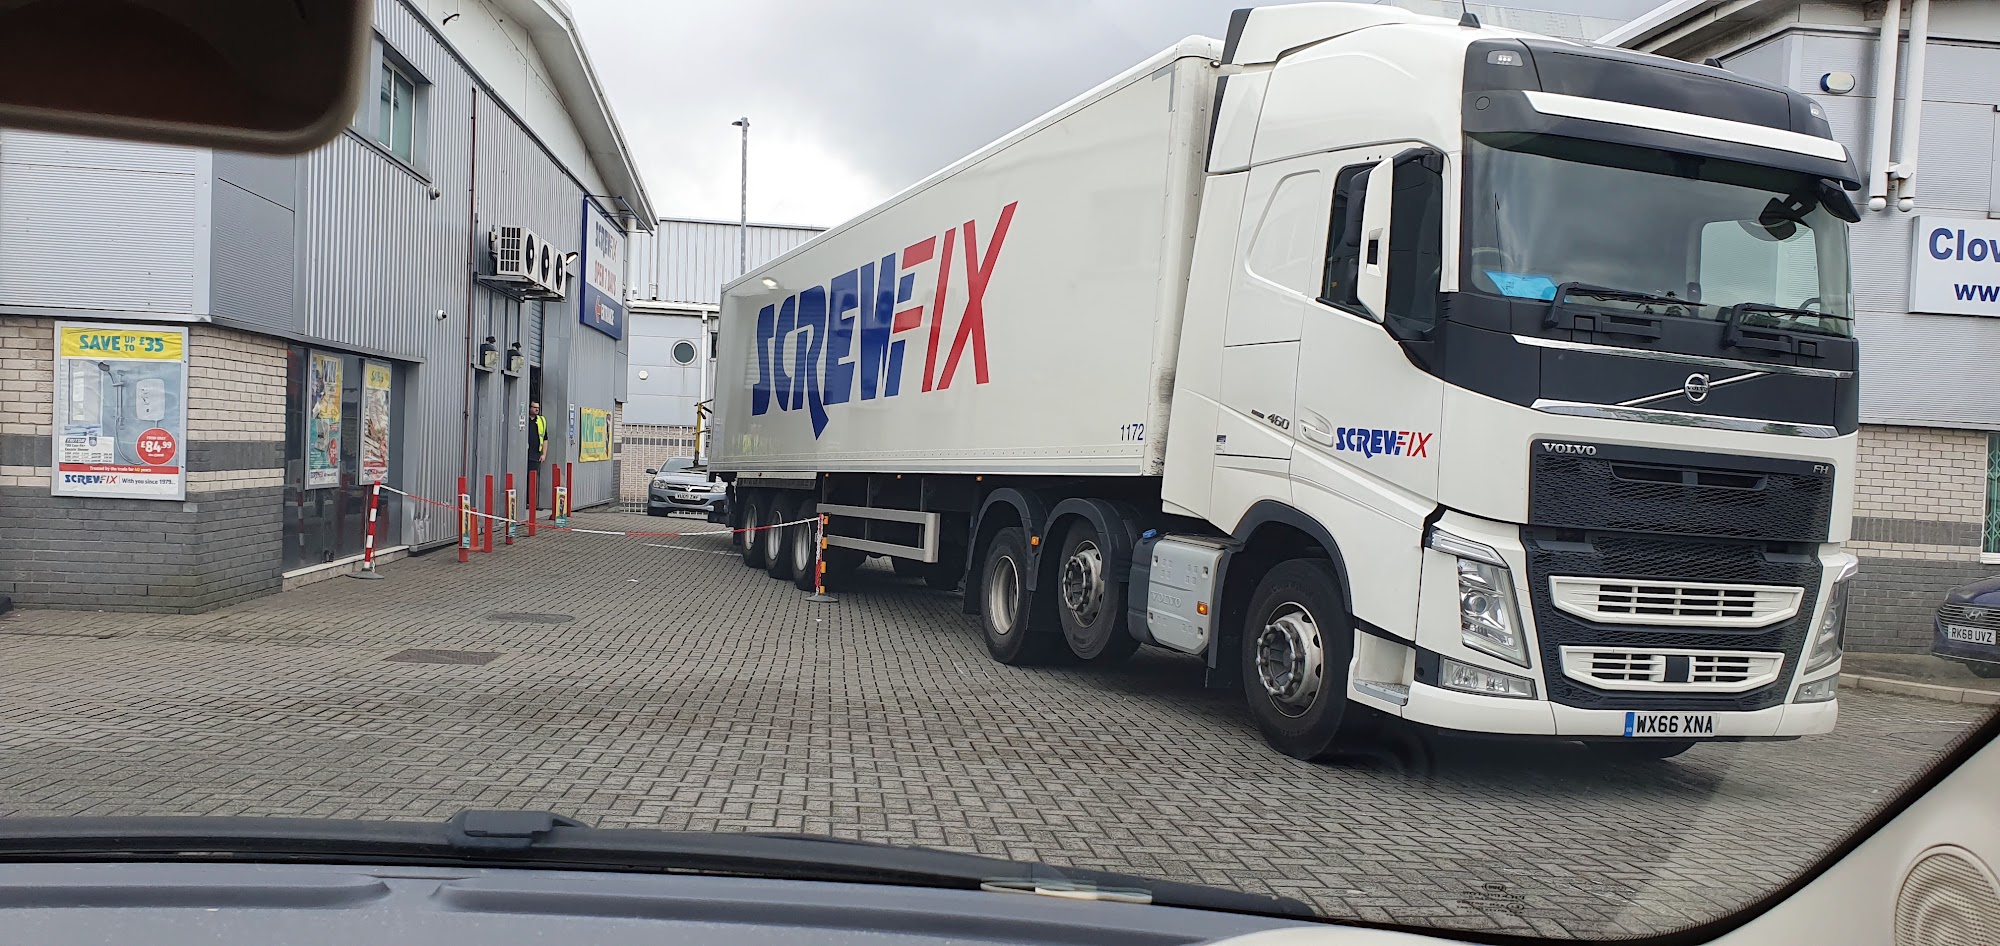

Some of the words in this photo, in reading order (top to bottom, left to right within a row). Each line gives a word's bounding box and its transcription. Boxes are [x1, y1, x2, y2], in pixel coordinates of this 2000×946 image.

[752, 201, 1018, 440] SCREWFIX
[79, 334, 121, 351] SAVE
[139, 336, 164, 352] £35
[124, 344, 135, 352] TO
[1267, 413, 1290, 430] 460
[1120, 423, 1144, 441] 1172
[140, 441, 172, 453] £84.99
[1336, 427, 1433, 459] SCREWFIX
[1541, 442, 1597, 456] VOLVO
[1812, 464, 1829, 475] FH
[64, 475, 118, 485] SCREWFIX
[1951, 627, 1973, 640] RK68
[1975, 631, 1992, 643] UVZ
[1636, 715, 1679, 733] WX66
[1682, 715, 1713, 733] XNA
